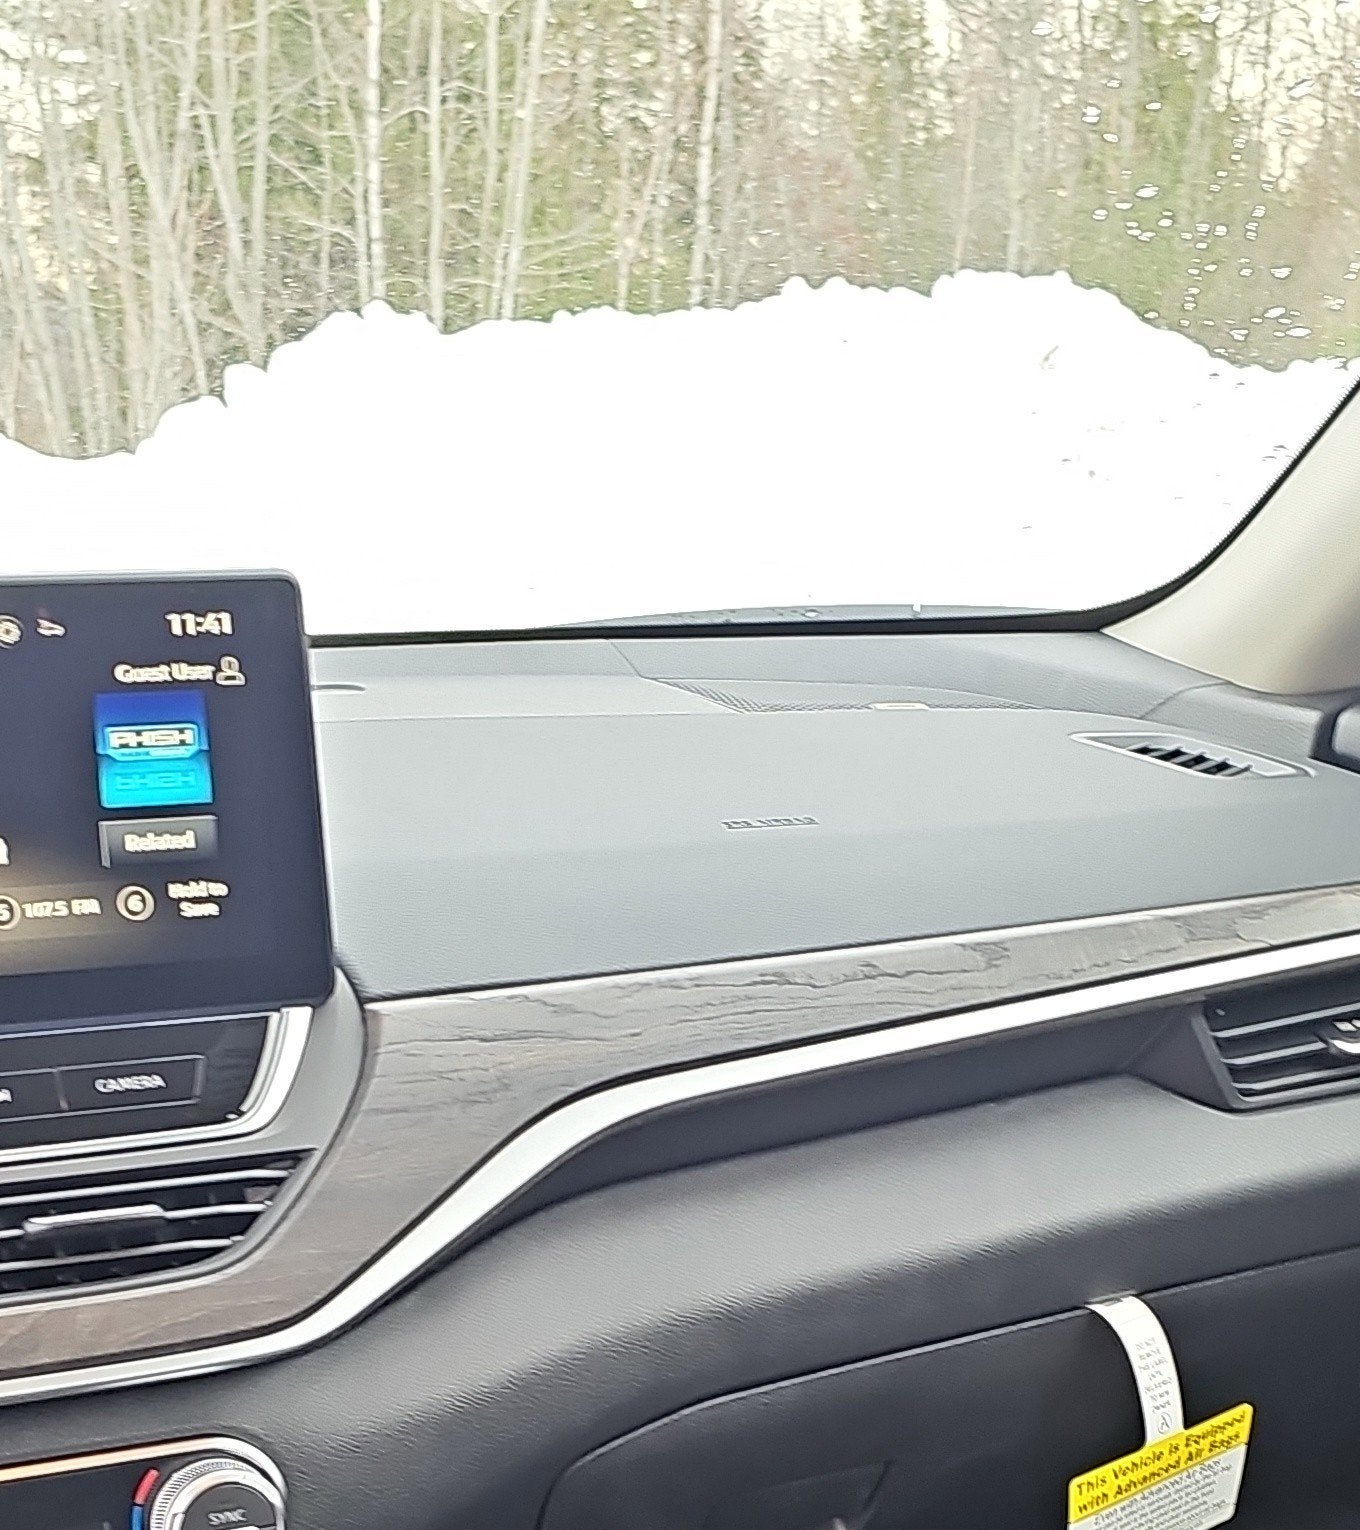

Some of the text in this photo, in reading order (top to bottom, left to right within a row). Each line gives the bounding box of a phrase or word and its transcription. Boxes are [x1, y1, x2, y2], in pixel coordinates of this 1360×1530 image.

[165, 612, 233, 636] 11:41
[114, 661, 216, 683] Guest User
[108, 729, 194, 748] PHISH
[124, 830, 197, 852] Related
[22, 900, 70, 919] 107.5
[71, 898, 102, 915] FM
[127, 894, 144, 912] 6
[94, 1074, 167, 1093] CAMERA
[1077, 1474, 1107, 1496] This
[1112, 1450, 1165, 1480] Vehicle
[1078, 1492, 1109, 1514] with
[207, 1508, 248, 1526] SYNC
